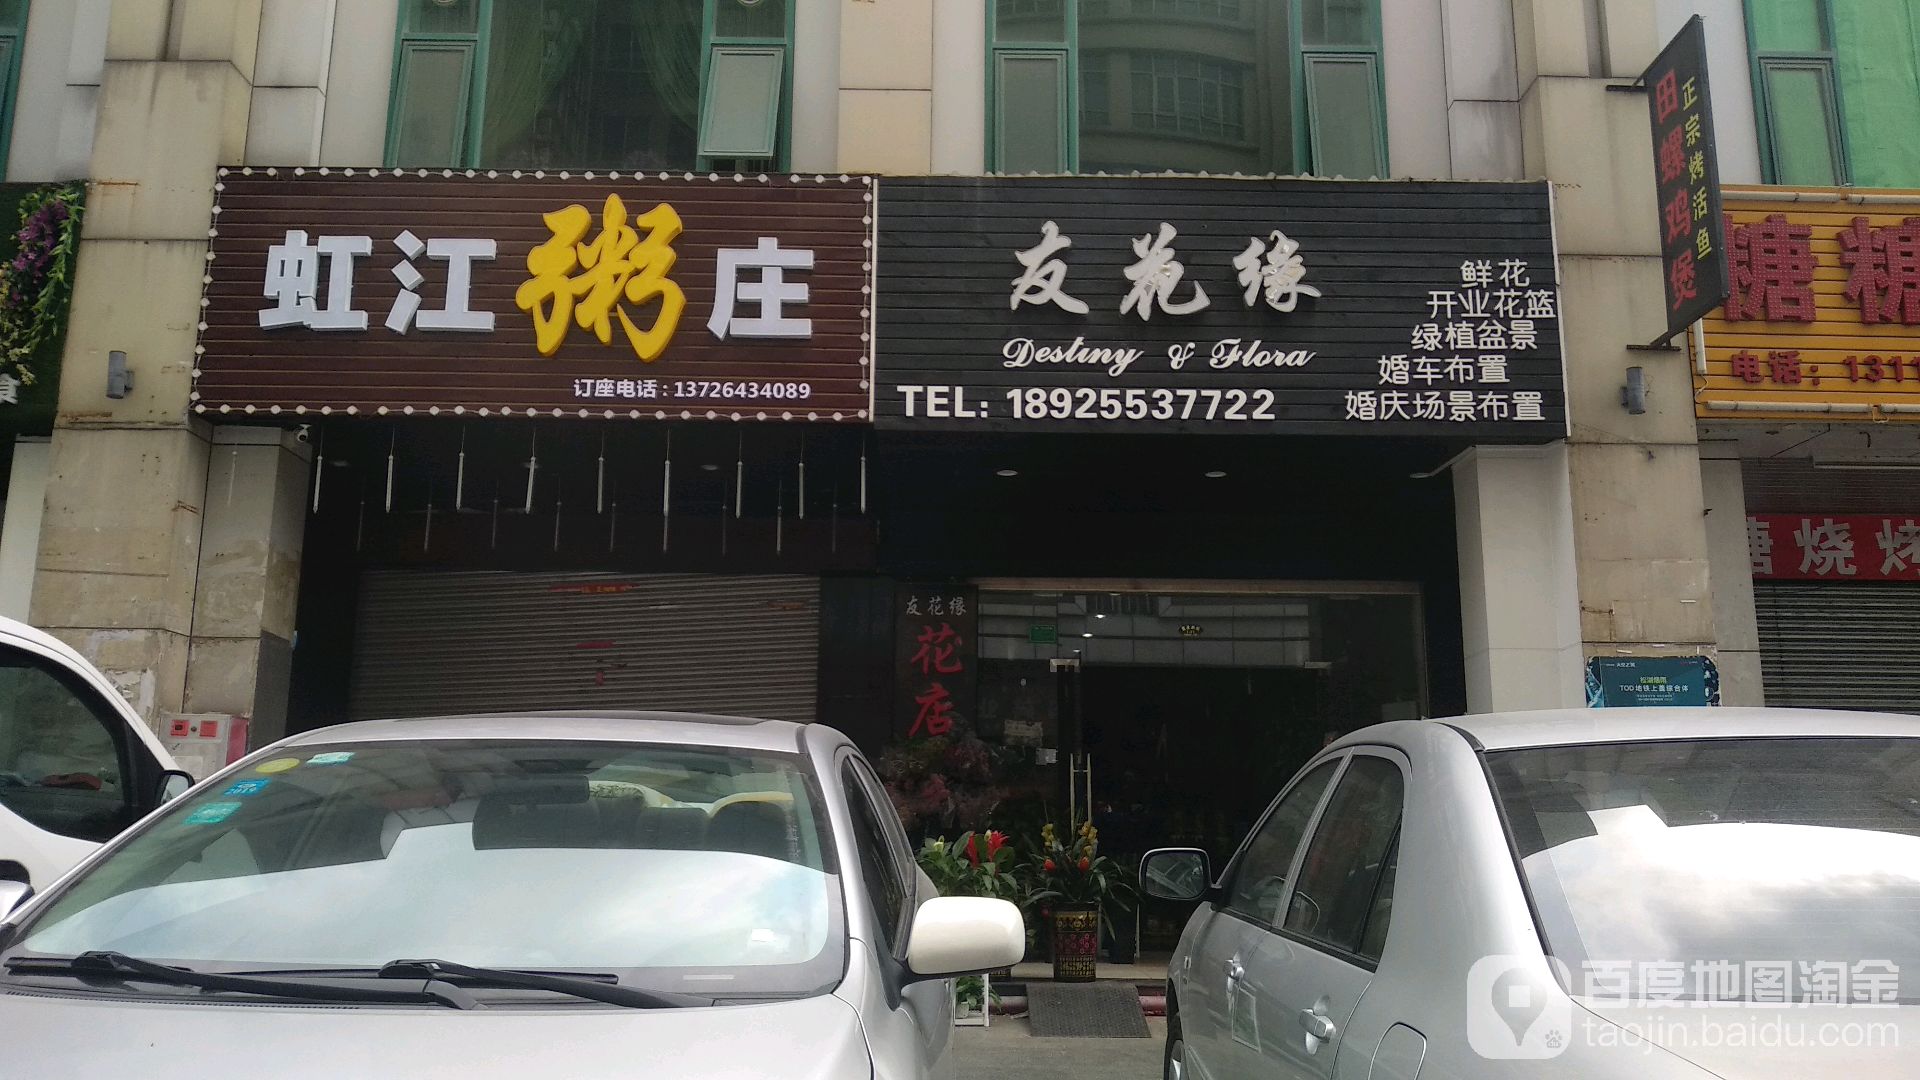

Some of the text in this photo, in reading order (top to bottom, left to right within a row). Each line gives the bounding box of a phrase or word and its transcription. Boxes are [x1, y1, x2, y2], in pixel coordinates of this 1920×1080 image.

[1682, 75, 1712, 260] 正宗烤活鱼
[1656, 68, 1697, 311] 田螺鸡煲
[259, 193, 815, 362] 虹江粥庄
[1009, 221, 1322, 321] 友花缘
[1460, 258, 1530, 289] 鲜花
[1426, 288, 1556, 319] 开业花篮
[1410, 319, 1538, 351] 绿植盆景
[1002, 336, 1317, 377] Destiny & Flora
[1377, 354, 1510, 386] 婚车布置
[896, 385, 1276, 420] TEL: 18925537722
[1344, 389, 1545, 421] 婚庆场景布置
[906, 596, 967, 616] 友花缘
[908, 622, 964, 737] 花店
